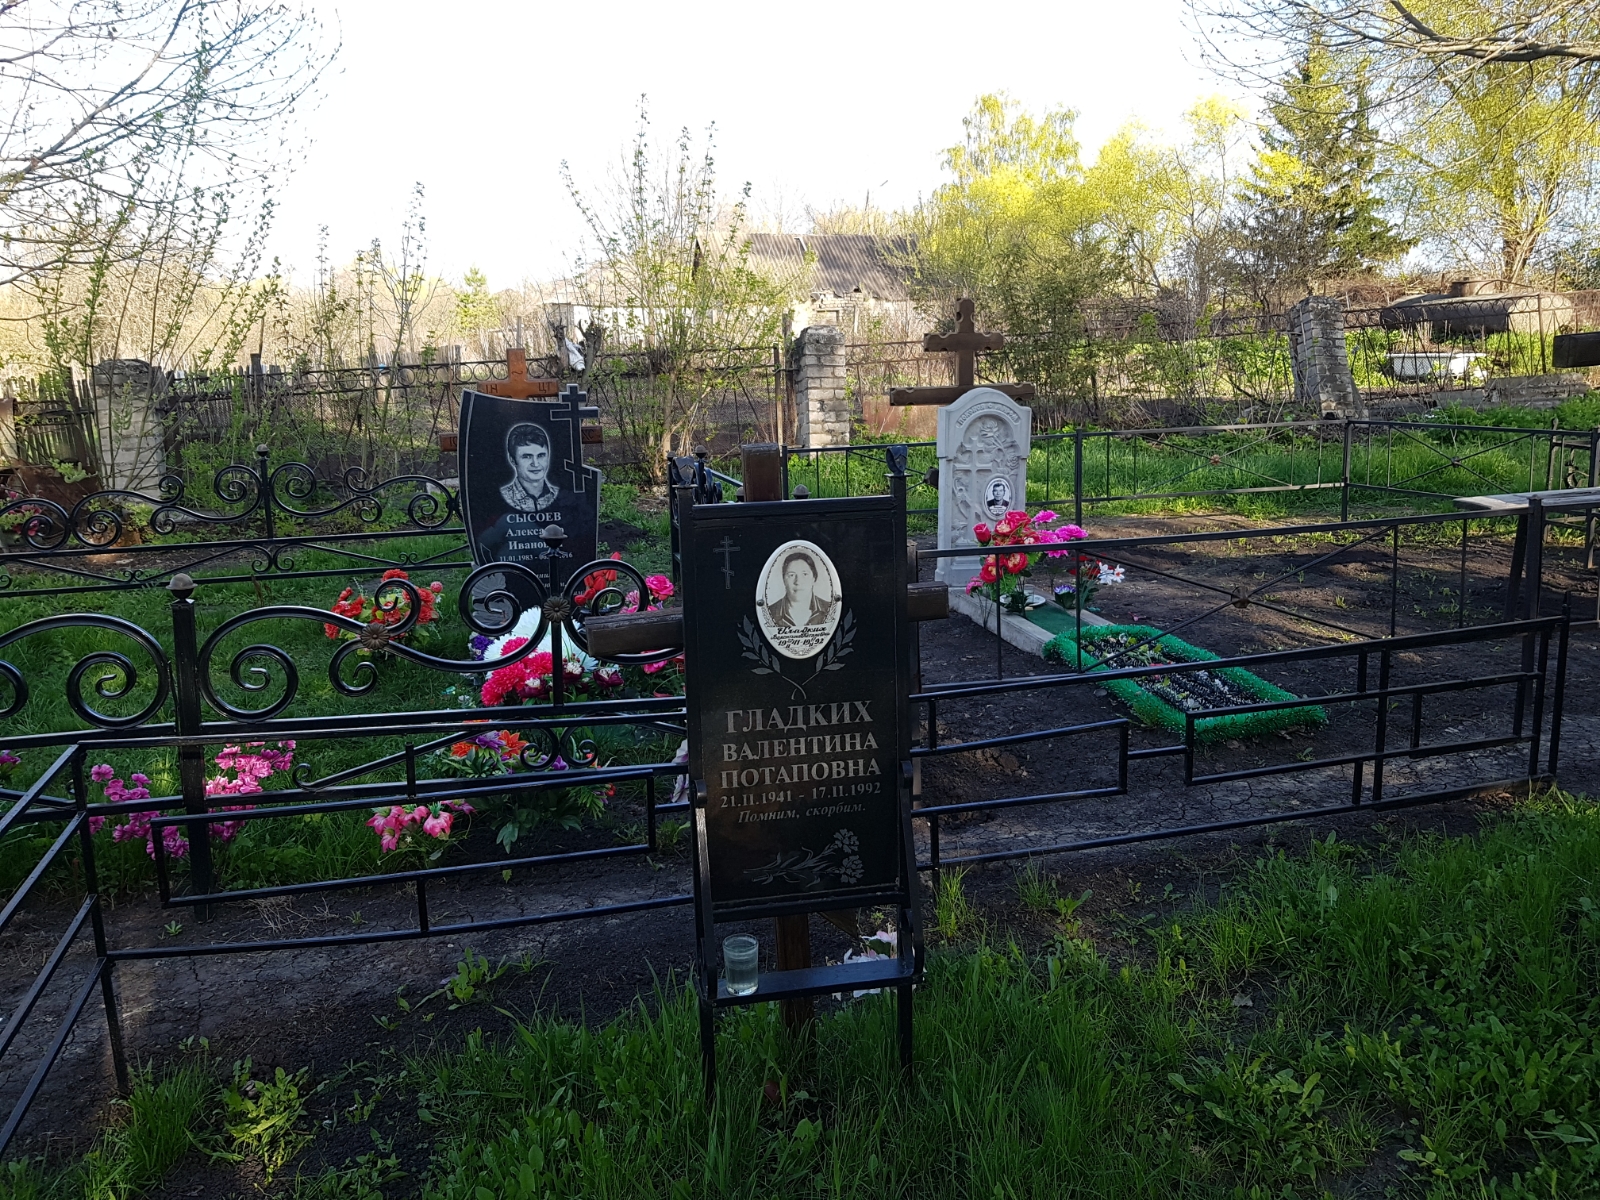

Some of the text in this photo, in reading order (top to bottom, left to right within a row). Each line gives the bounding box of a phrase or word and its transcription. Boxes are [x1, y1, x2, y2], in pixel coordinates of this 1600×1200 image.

[506, 512, 562, 523] СЫСОЕВ
[505, 526, 565, 538] Алекса
[725, 700, 873, 733] ГЛАДКИХ
[722, 732, 879, 762] ВАЛЕНТИНА
[720, 757, 882, 789] ПОТАПОВНА
[737, 801, 866, 824] Помним, скорбим.
